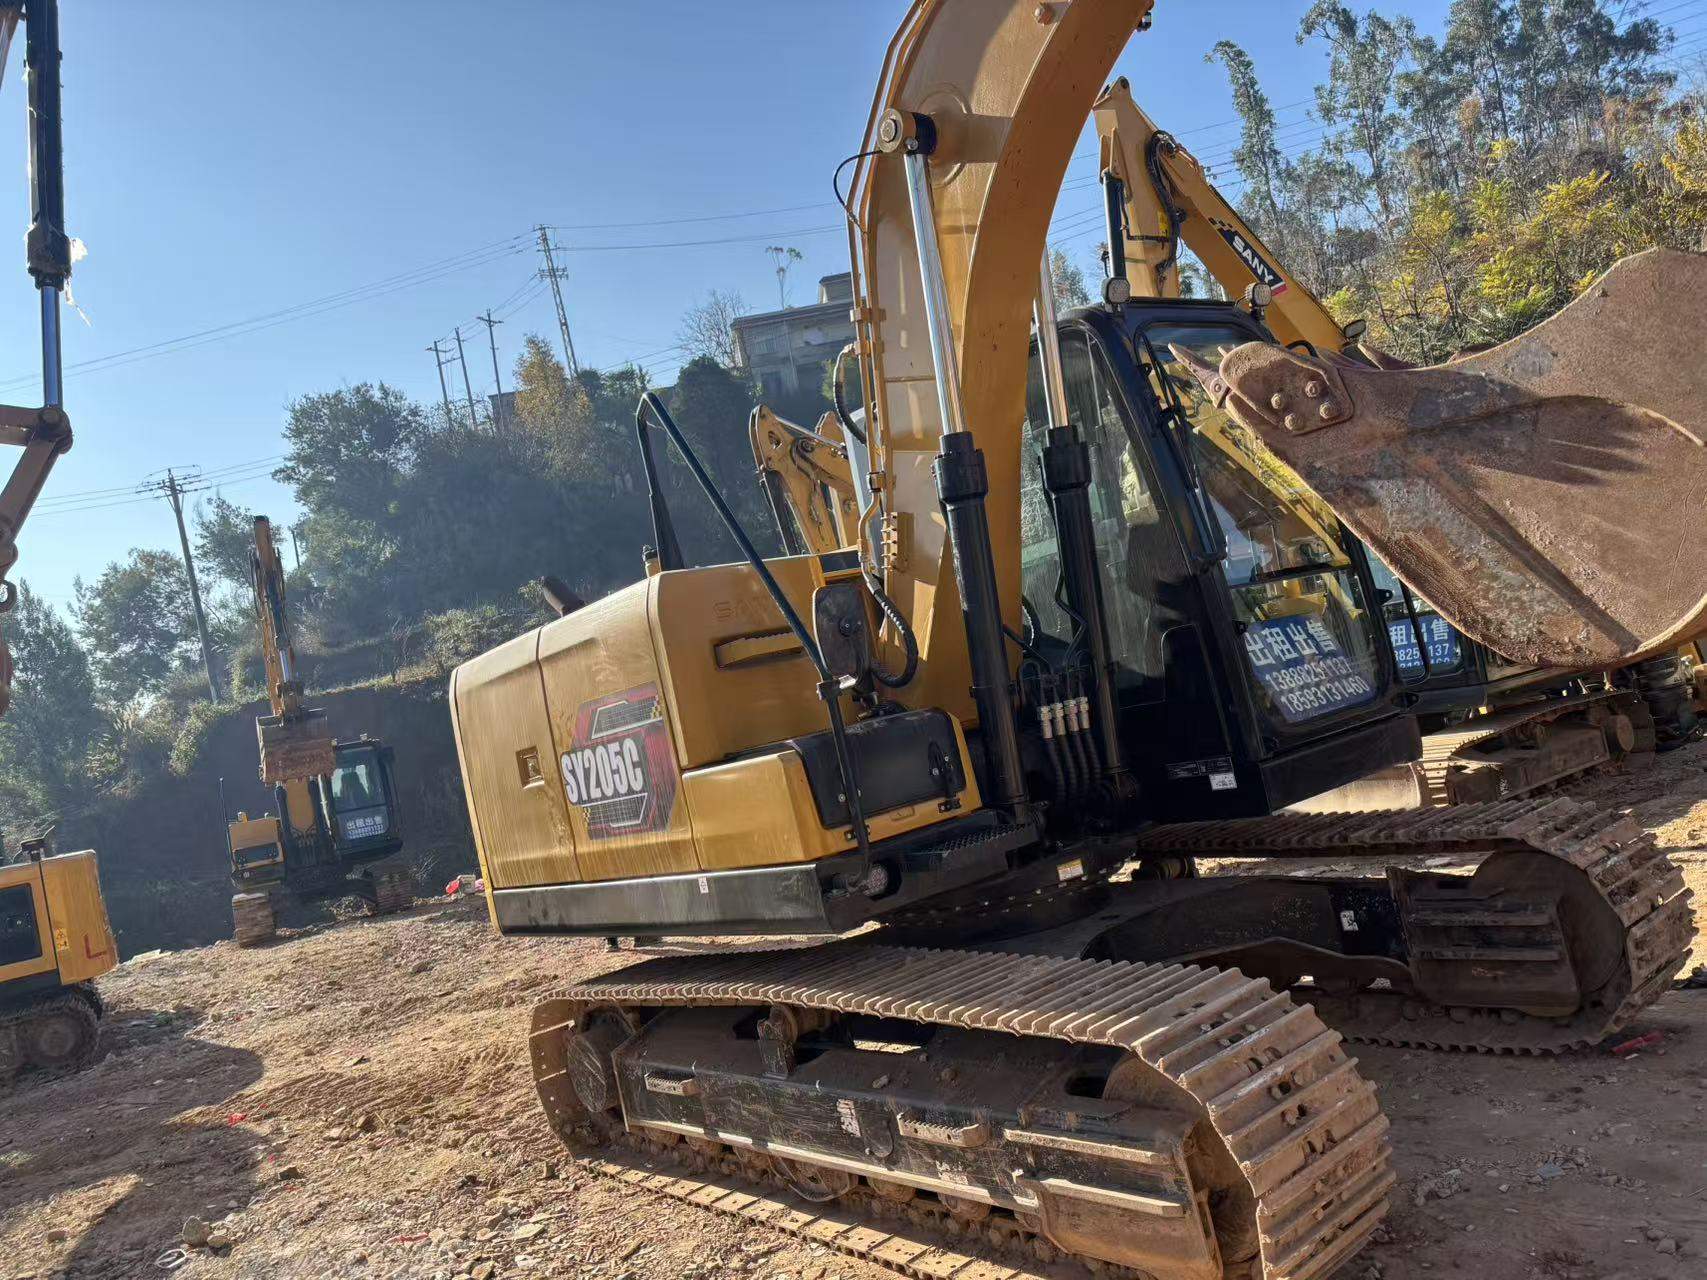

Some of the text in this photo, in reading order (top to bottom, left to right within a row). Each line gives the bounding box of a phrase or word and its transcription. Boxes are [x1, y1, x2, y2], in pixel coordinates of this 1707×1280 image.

[1232, 235, 1274, 283] SANY
[1245, 620, 1337, 666] 出租出售
[1265, 657, 1352, 691] 13888251137
[1281, 676, 1370, 713] 18593131460
[561, 738, 643, 803] SY205C
